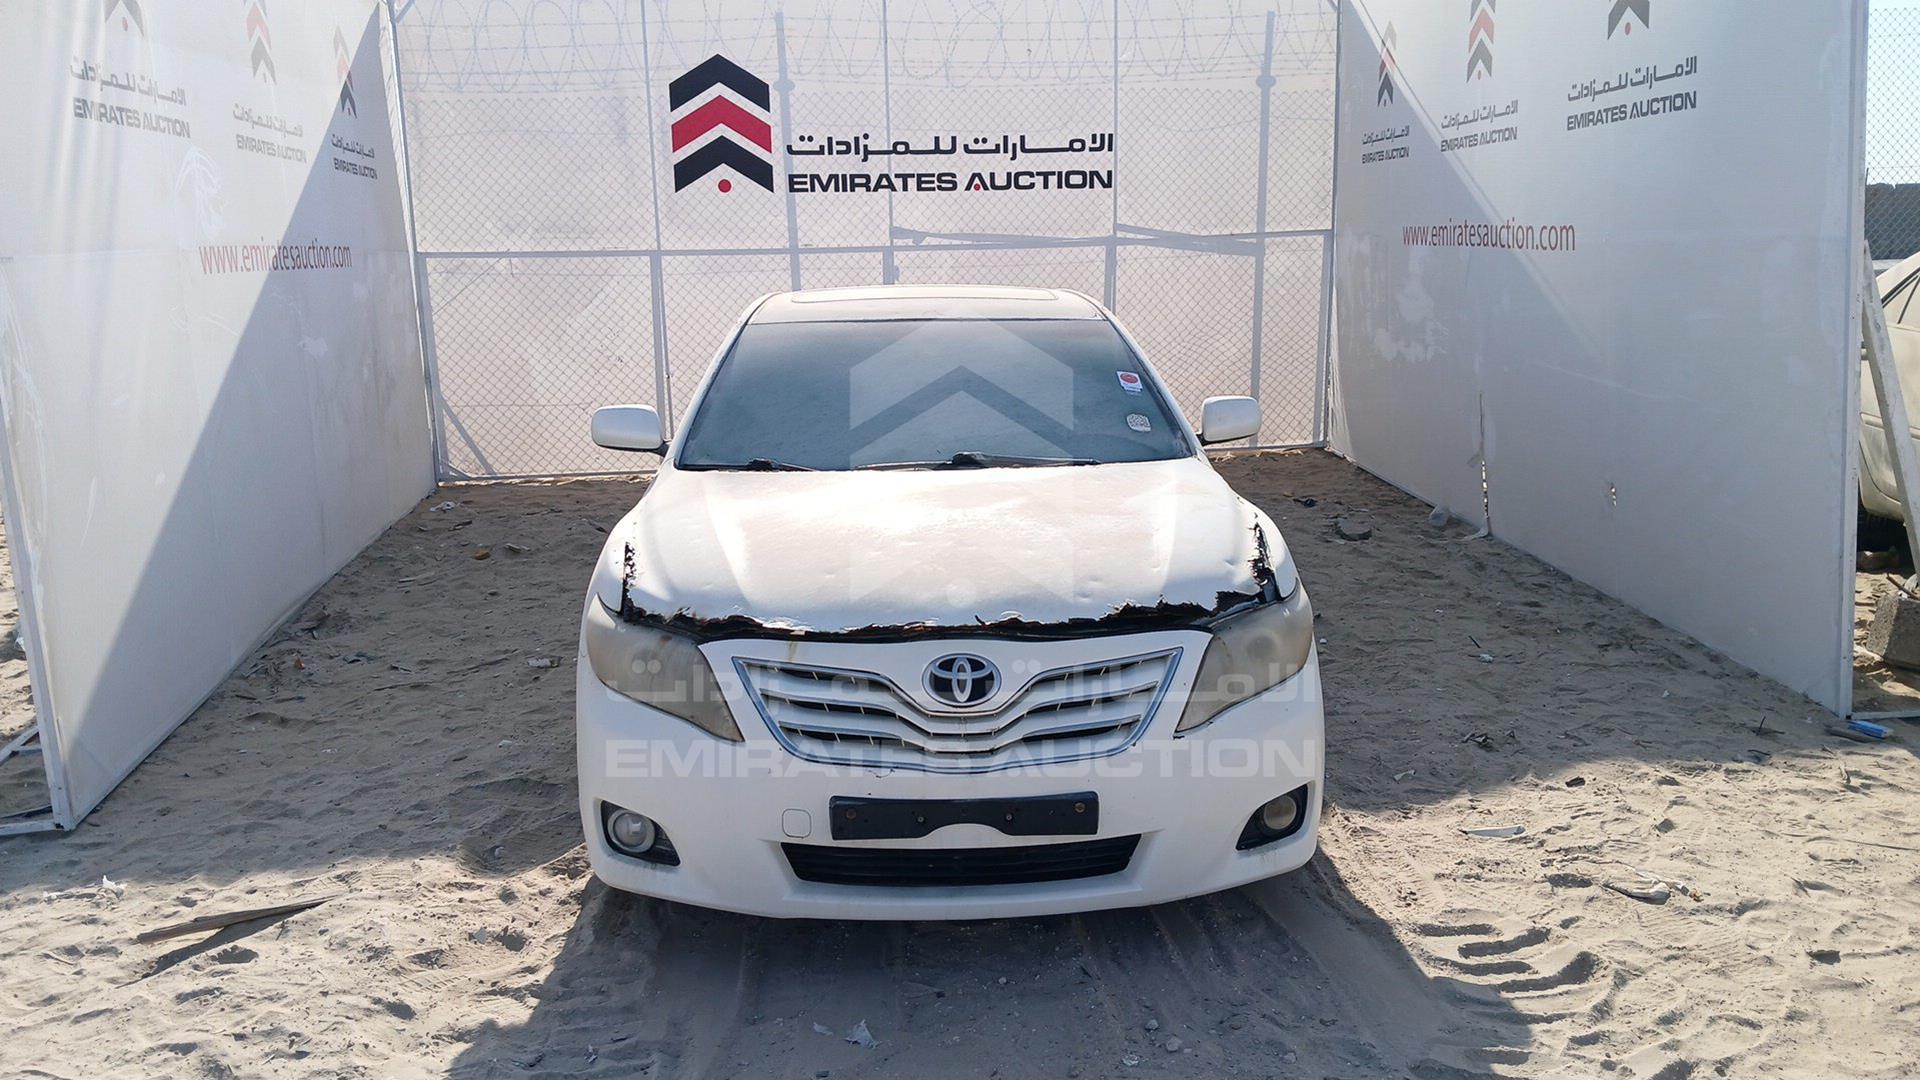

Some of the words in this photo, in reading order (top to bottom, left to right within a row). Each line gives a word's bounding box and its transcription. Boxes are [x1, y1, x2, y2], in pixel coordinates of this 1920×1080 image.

[1567, 72, 1628, 102] للمزادات
[73, 97, 141, 129] EMIRATES
[143, 112, 191, 138] AUCTION
[1567, 104, 1628, 131] EMIRATES
[1629, 91, 1697, 119] AUCTION
[235, 134, 277, 157] EMIRATES
[277, 144, 307, 163] AUCTION
[786, 133, 957, 163] للمزادات
[963, 133, 1114, 161] الامارات
[1441, 136, 1479, 152] EMIRATES
[1479, 127, 1519, 146] AUCTION
[333, 157, 358, 175] EMIRATES
[1362, 150, 1384, 164] EMIRATES
[1385, 147, 1410, 161] AUCTION
[787, 172, 958, 193] EMIRATES
[964, 169, 1113, 191] AUCTION
[1402, 217, 1577, 251] www.emiratesauction.com
[199, 236, 352, 275] www.emiratesauction.com
